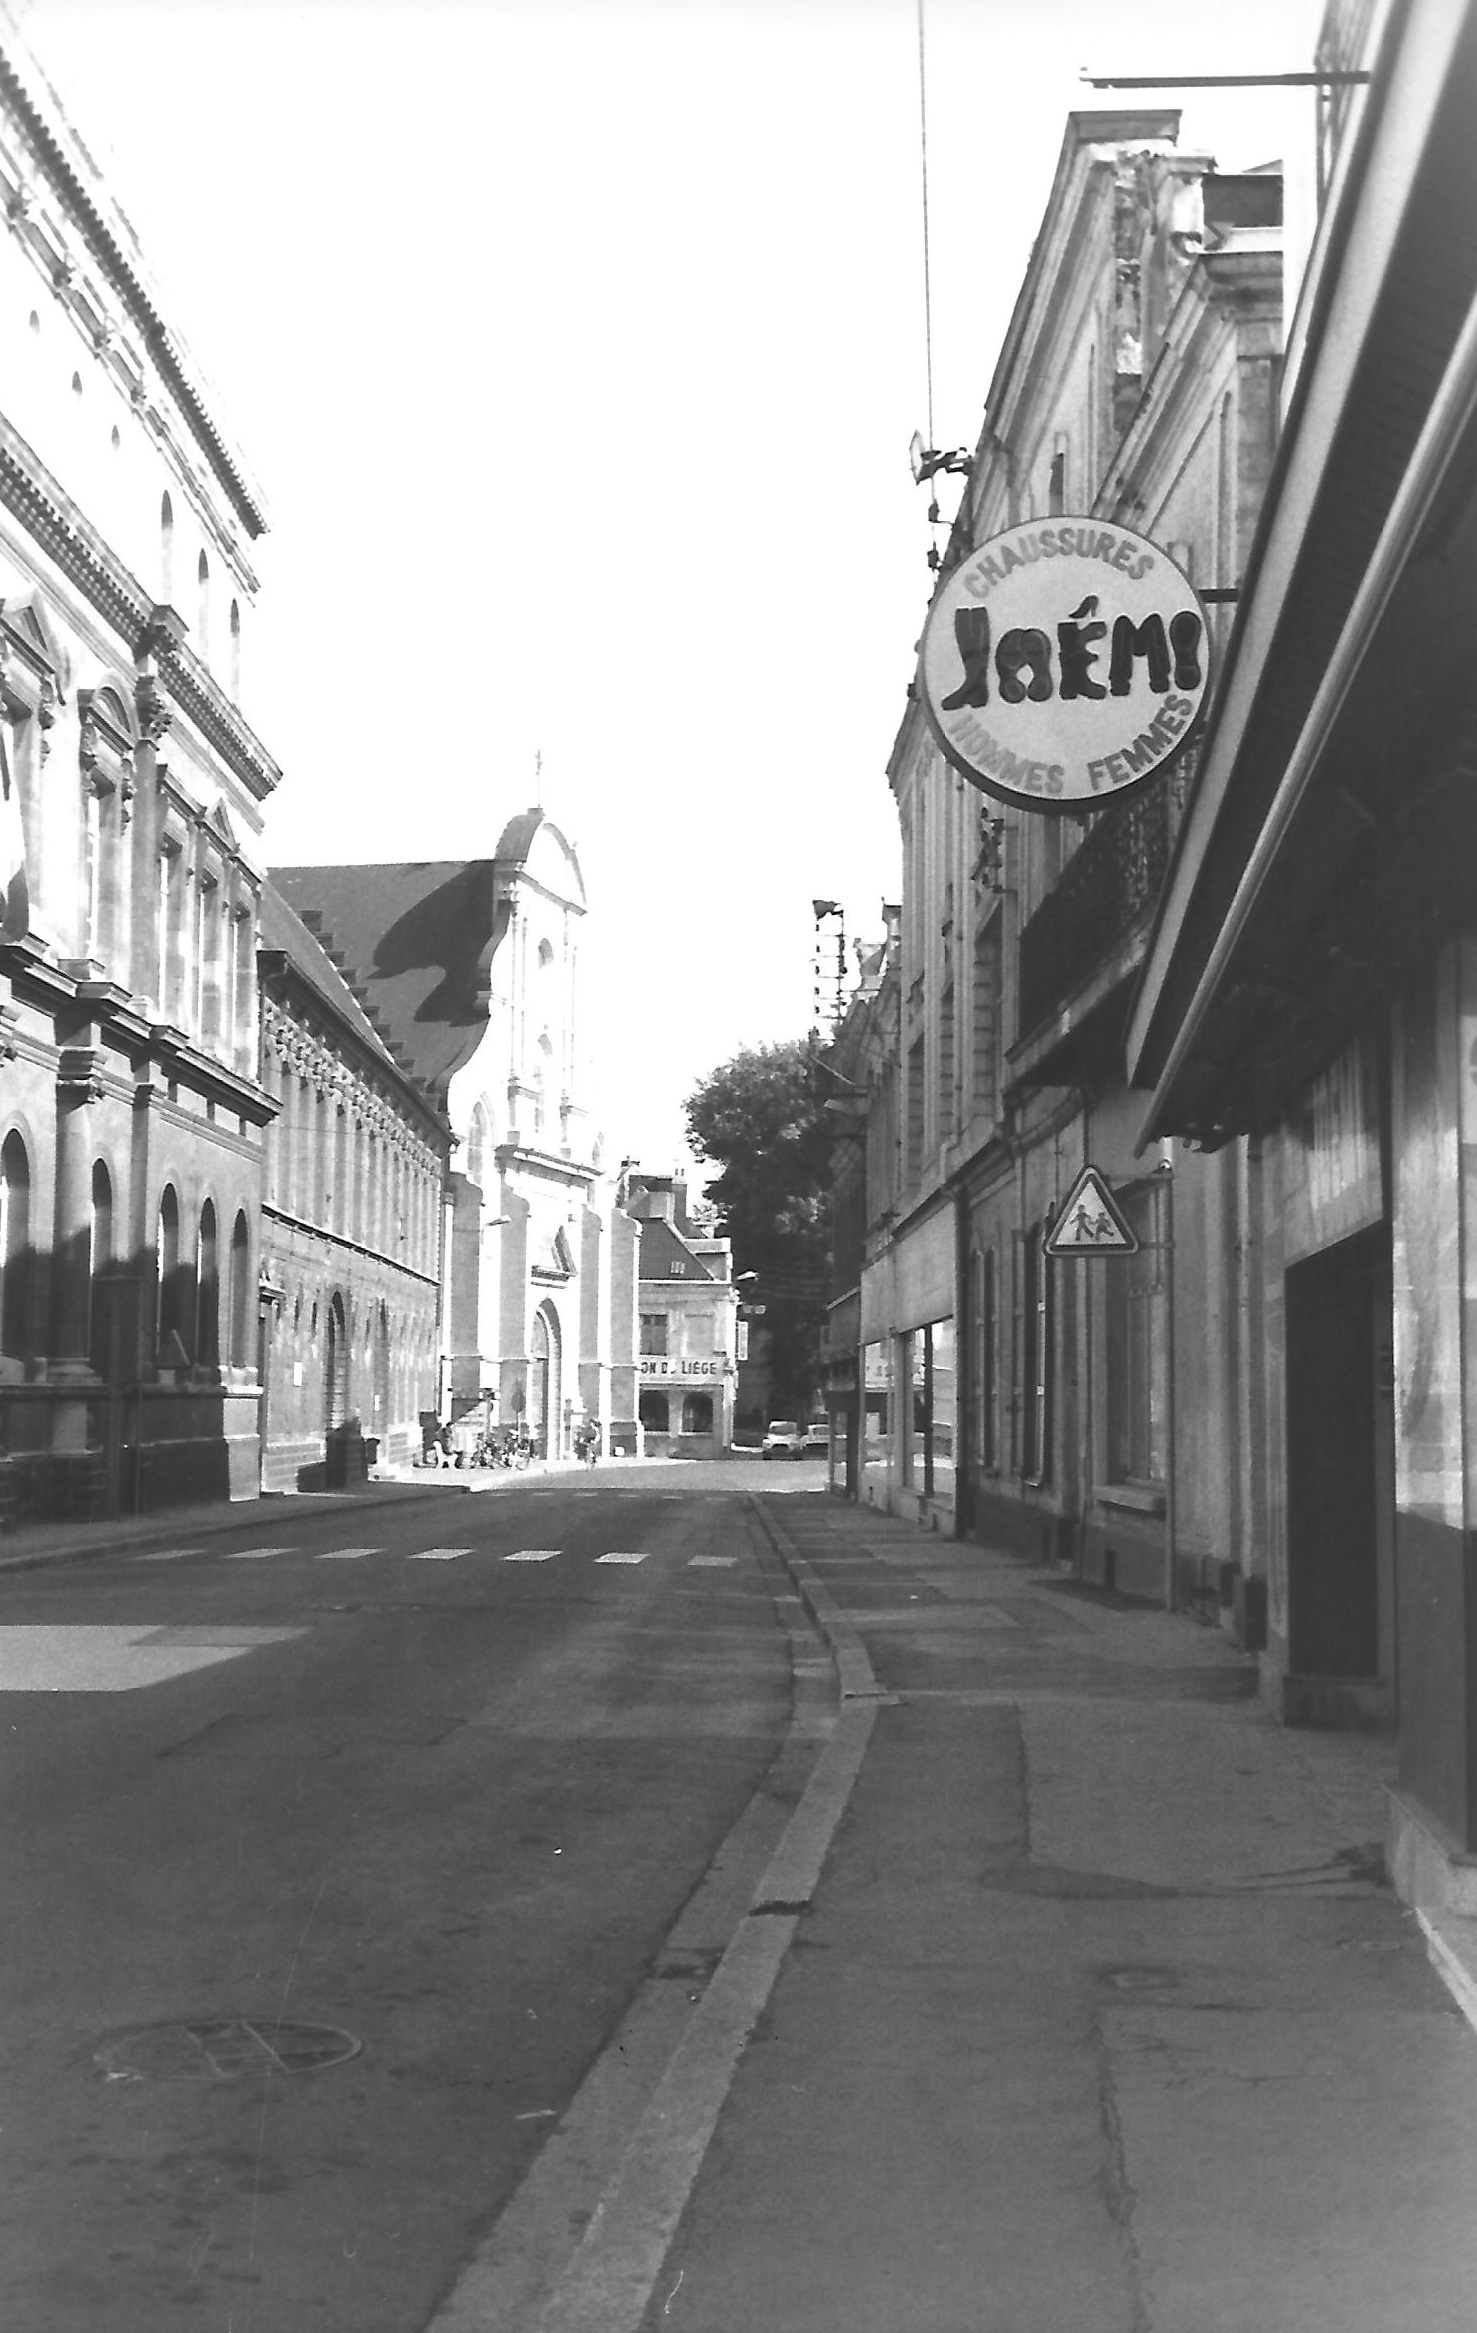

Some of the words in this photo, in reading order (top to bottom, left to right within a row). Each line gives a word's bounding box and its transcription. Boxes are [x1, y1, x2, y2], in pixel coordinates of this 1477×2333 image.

[963, 527, 1155, 598] CHAUSSURES
[948, 714, 1065, 793] HOMMES
[1087, 694, 1194, 790] FEMMES
